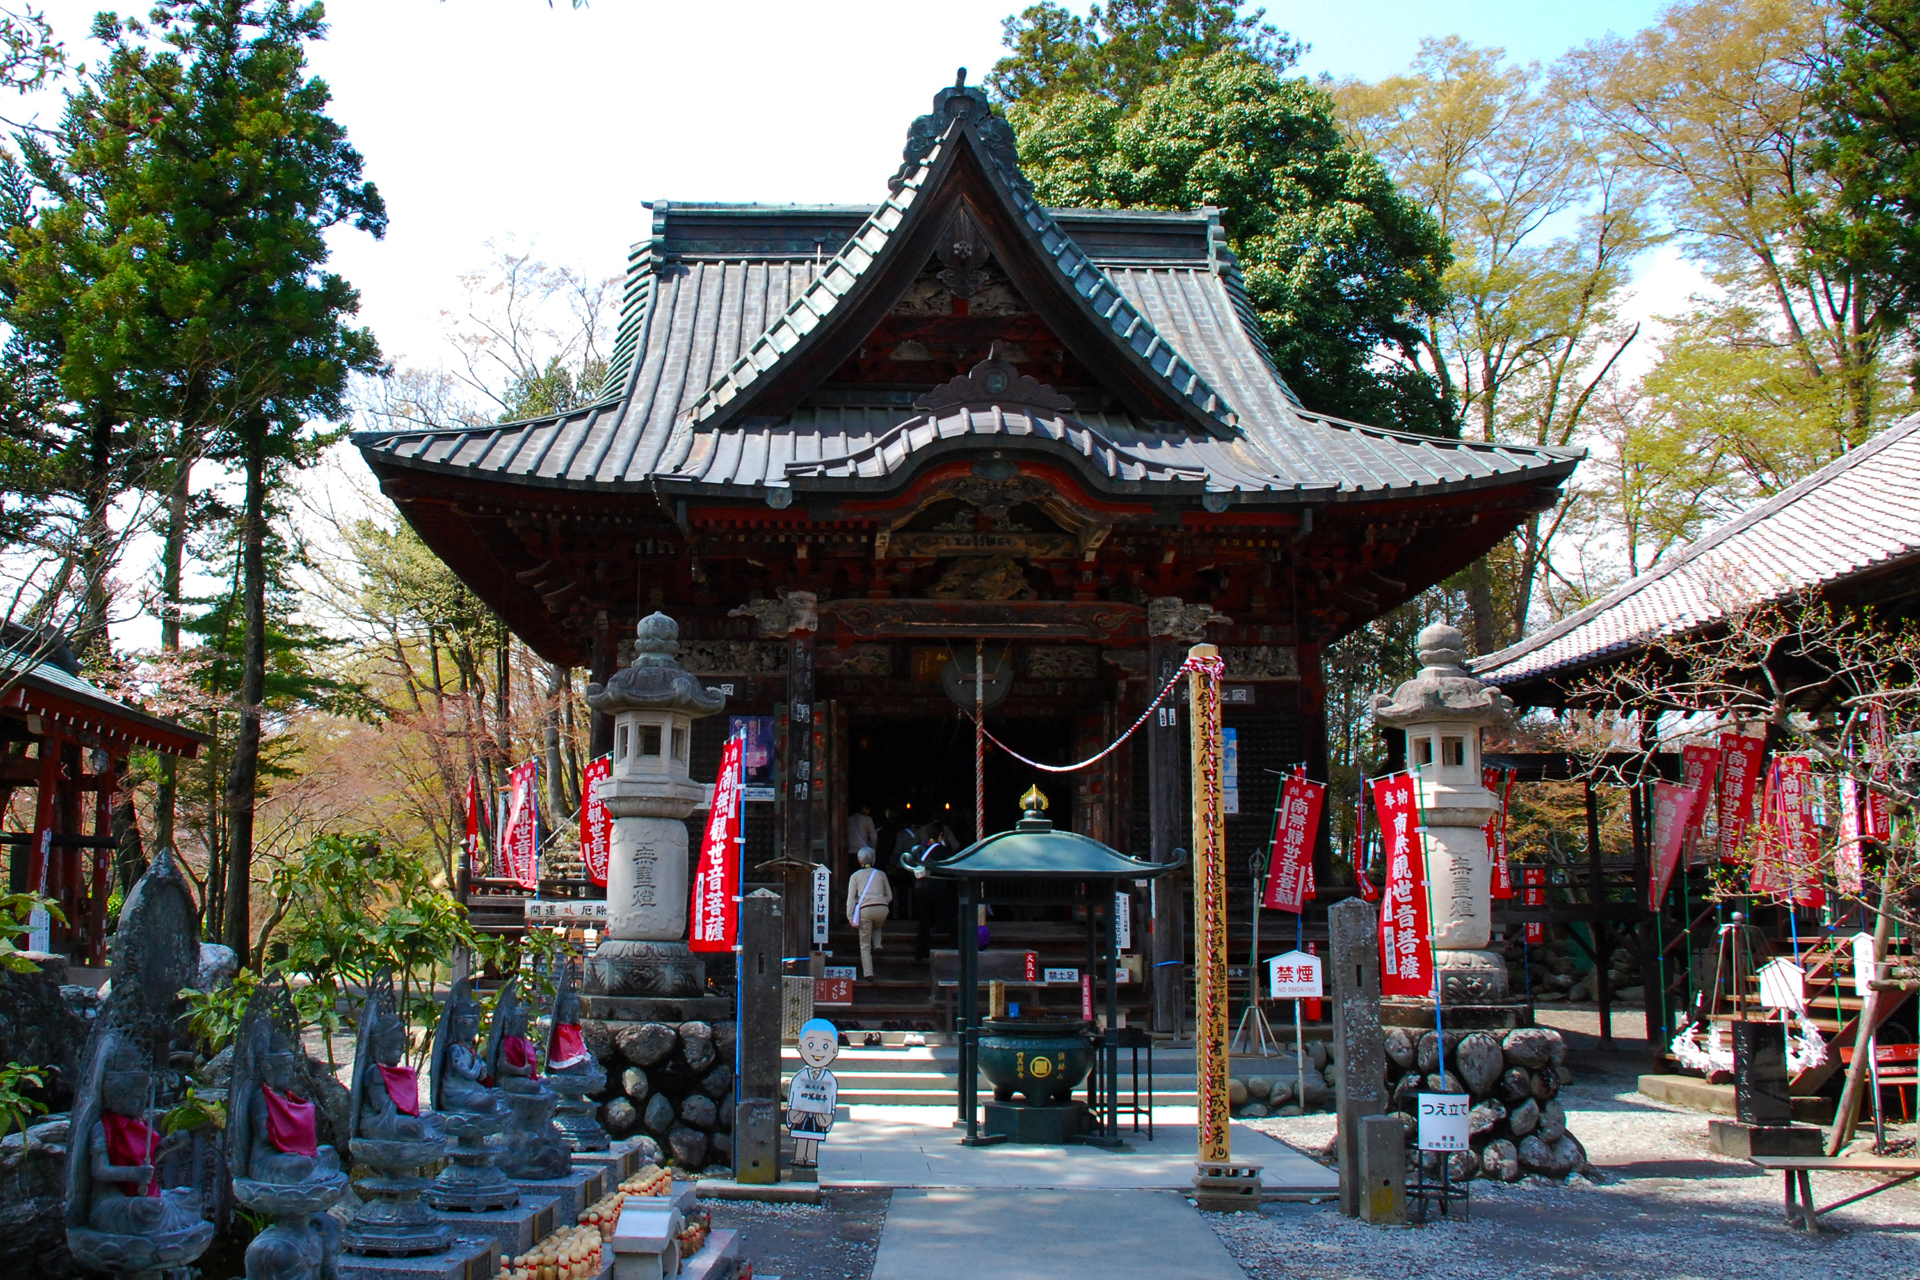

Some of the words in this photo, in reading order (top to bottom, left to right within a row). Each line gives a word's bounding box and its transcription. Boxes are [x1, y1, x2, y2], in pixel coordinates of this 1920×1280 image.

[1383, 788, 1409, 809] 奉納
[704, 764, 733, 942] 南無観世音菩薩
[816, 872, 826, 936] おたすけ観音
[1391, 811, 1421, 980] 南無観世音菩薩
[825, 968, 853, 979] 禁土足
[1026, 953, 1035, 981] 火気注
[1048, 970, 1076, 981] 禁土足
[1276, 965, 1314, 984] 禁煙
[1421, 1102, 1468, 1116] つえ立て
